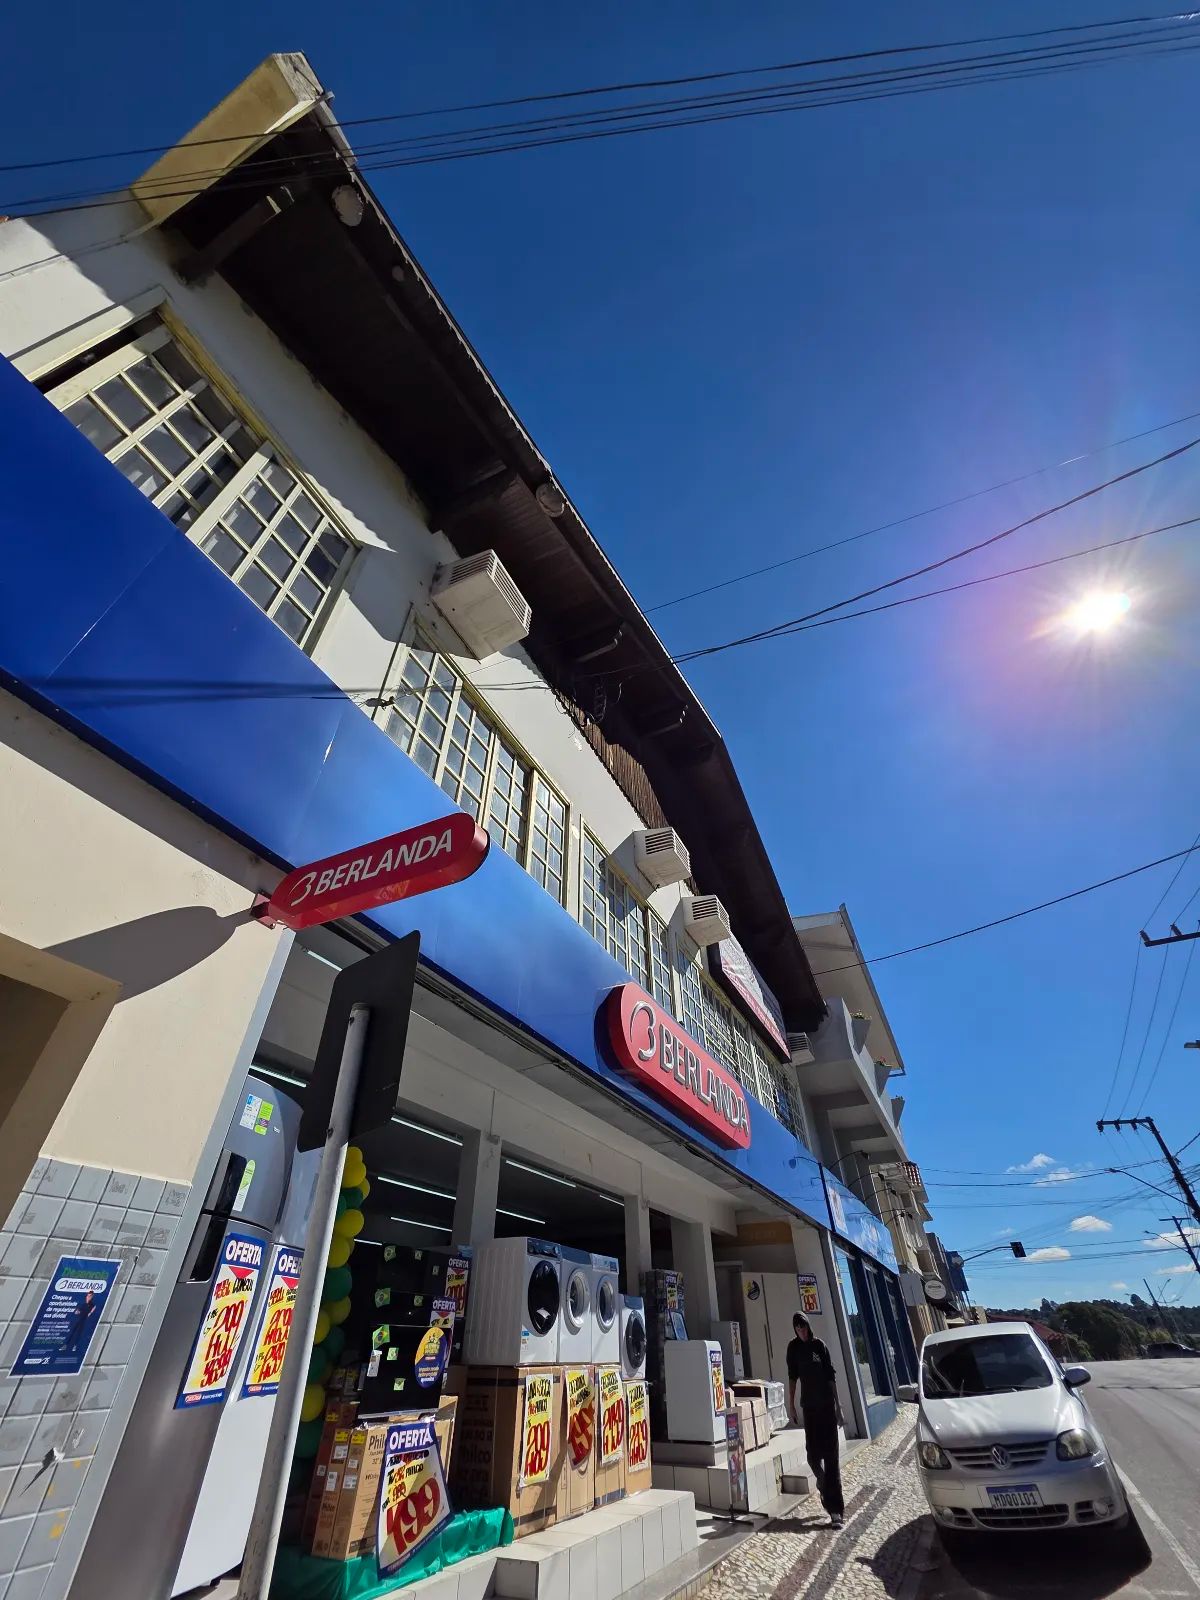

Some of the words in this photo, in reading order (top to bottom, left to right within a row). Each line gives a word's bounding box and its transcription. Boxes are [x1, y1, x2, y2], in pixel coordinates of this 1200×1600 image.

[314, 829, 452, 896] BERLANDA
[659, 1024, 749, 1136] BERLANDA
[225, 1240, 261, 1266] OFERTA
[448, 1258, 469, 1269] OFERTA
[67, 1281, 104, 1291] BERLANDA
[432, 1300, 456, 1311] OFERTA
[369, 1435, 386, 1451] Phil
[389, 1428, 433, 1450] OFERTA
